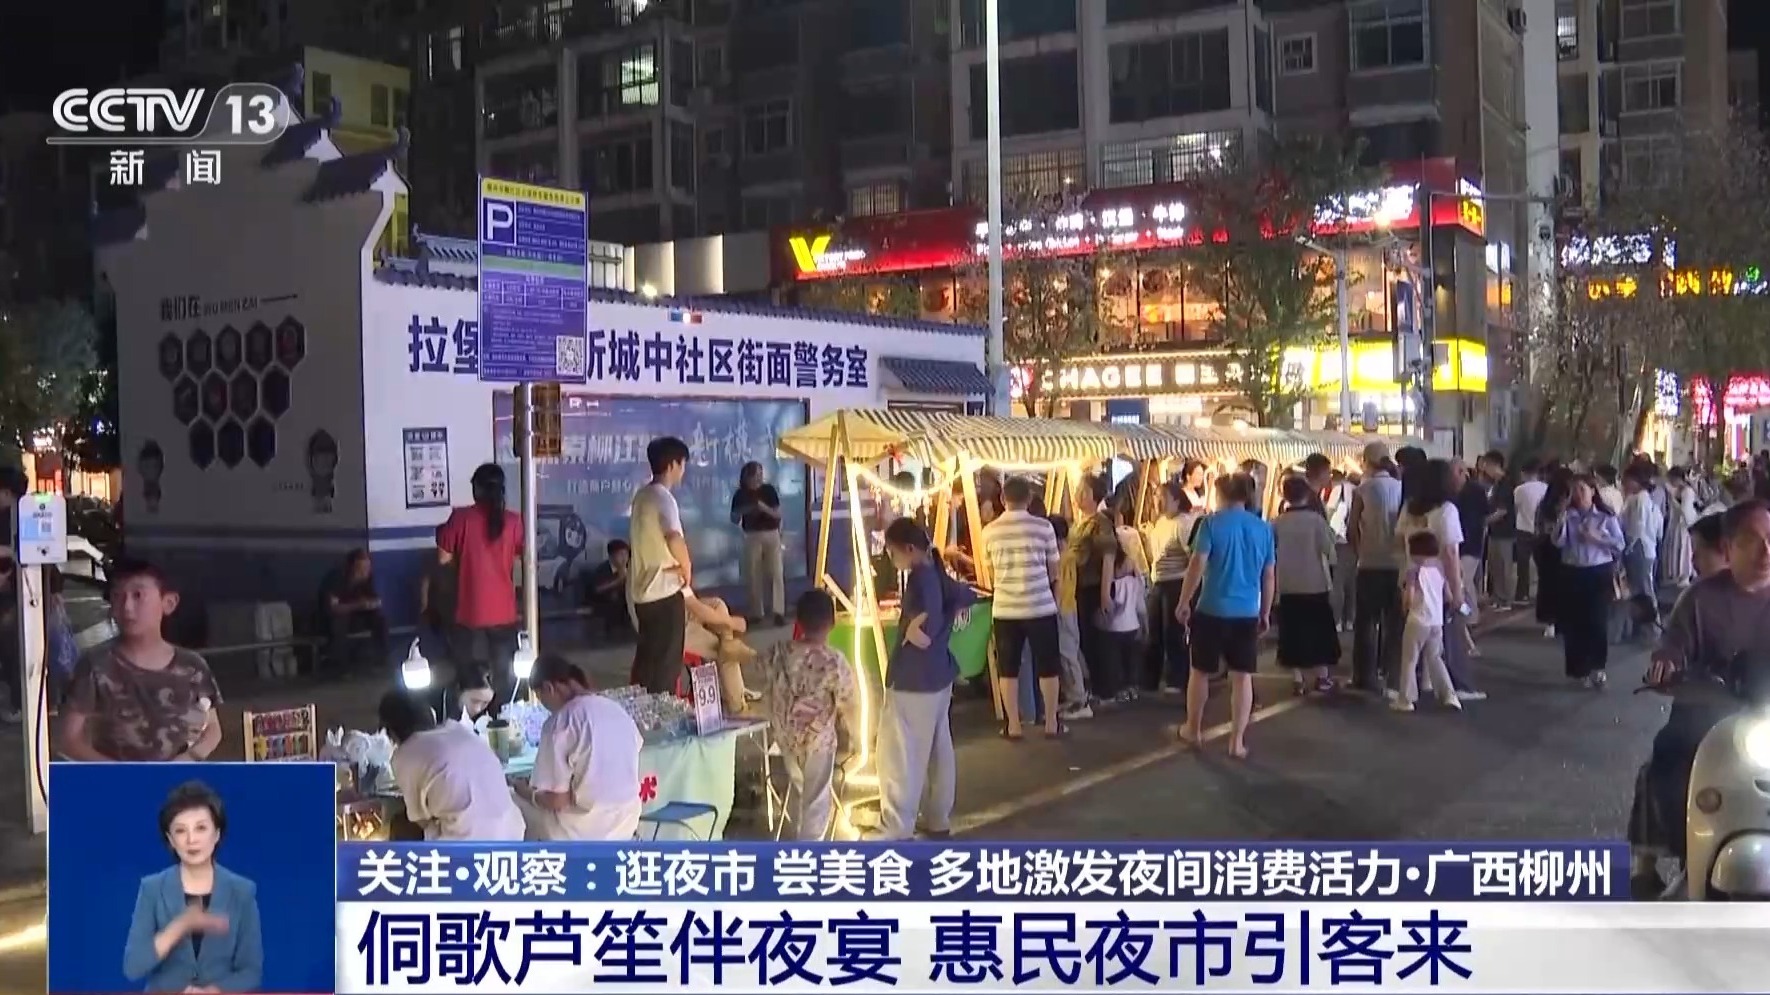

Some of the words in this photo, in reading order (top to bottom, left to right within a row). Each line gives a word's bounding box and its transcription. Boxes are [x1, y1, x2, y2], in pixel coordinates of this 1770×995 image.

[486, 201, 514, 240] P
[407, 313, 869, 389] 拉堡城中社区街面警务室
[698, 685, 717, 707] 9.9
